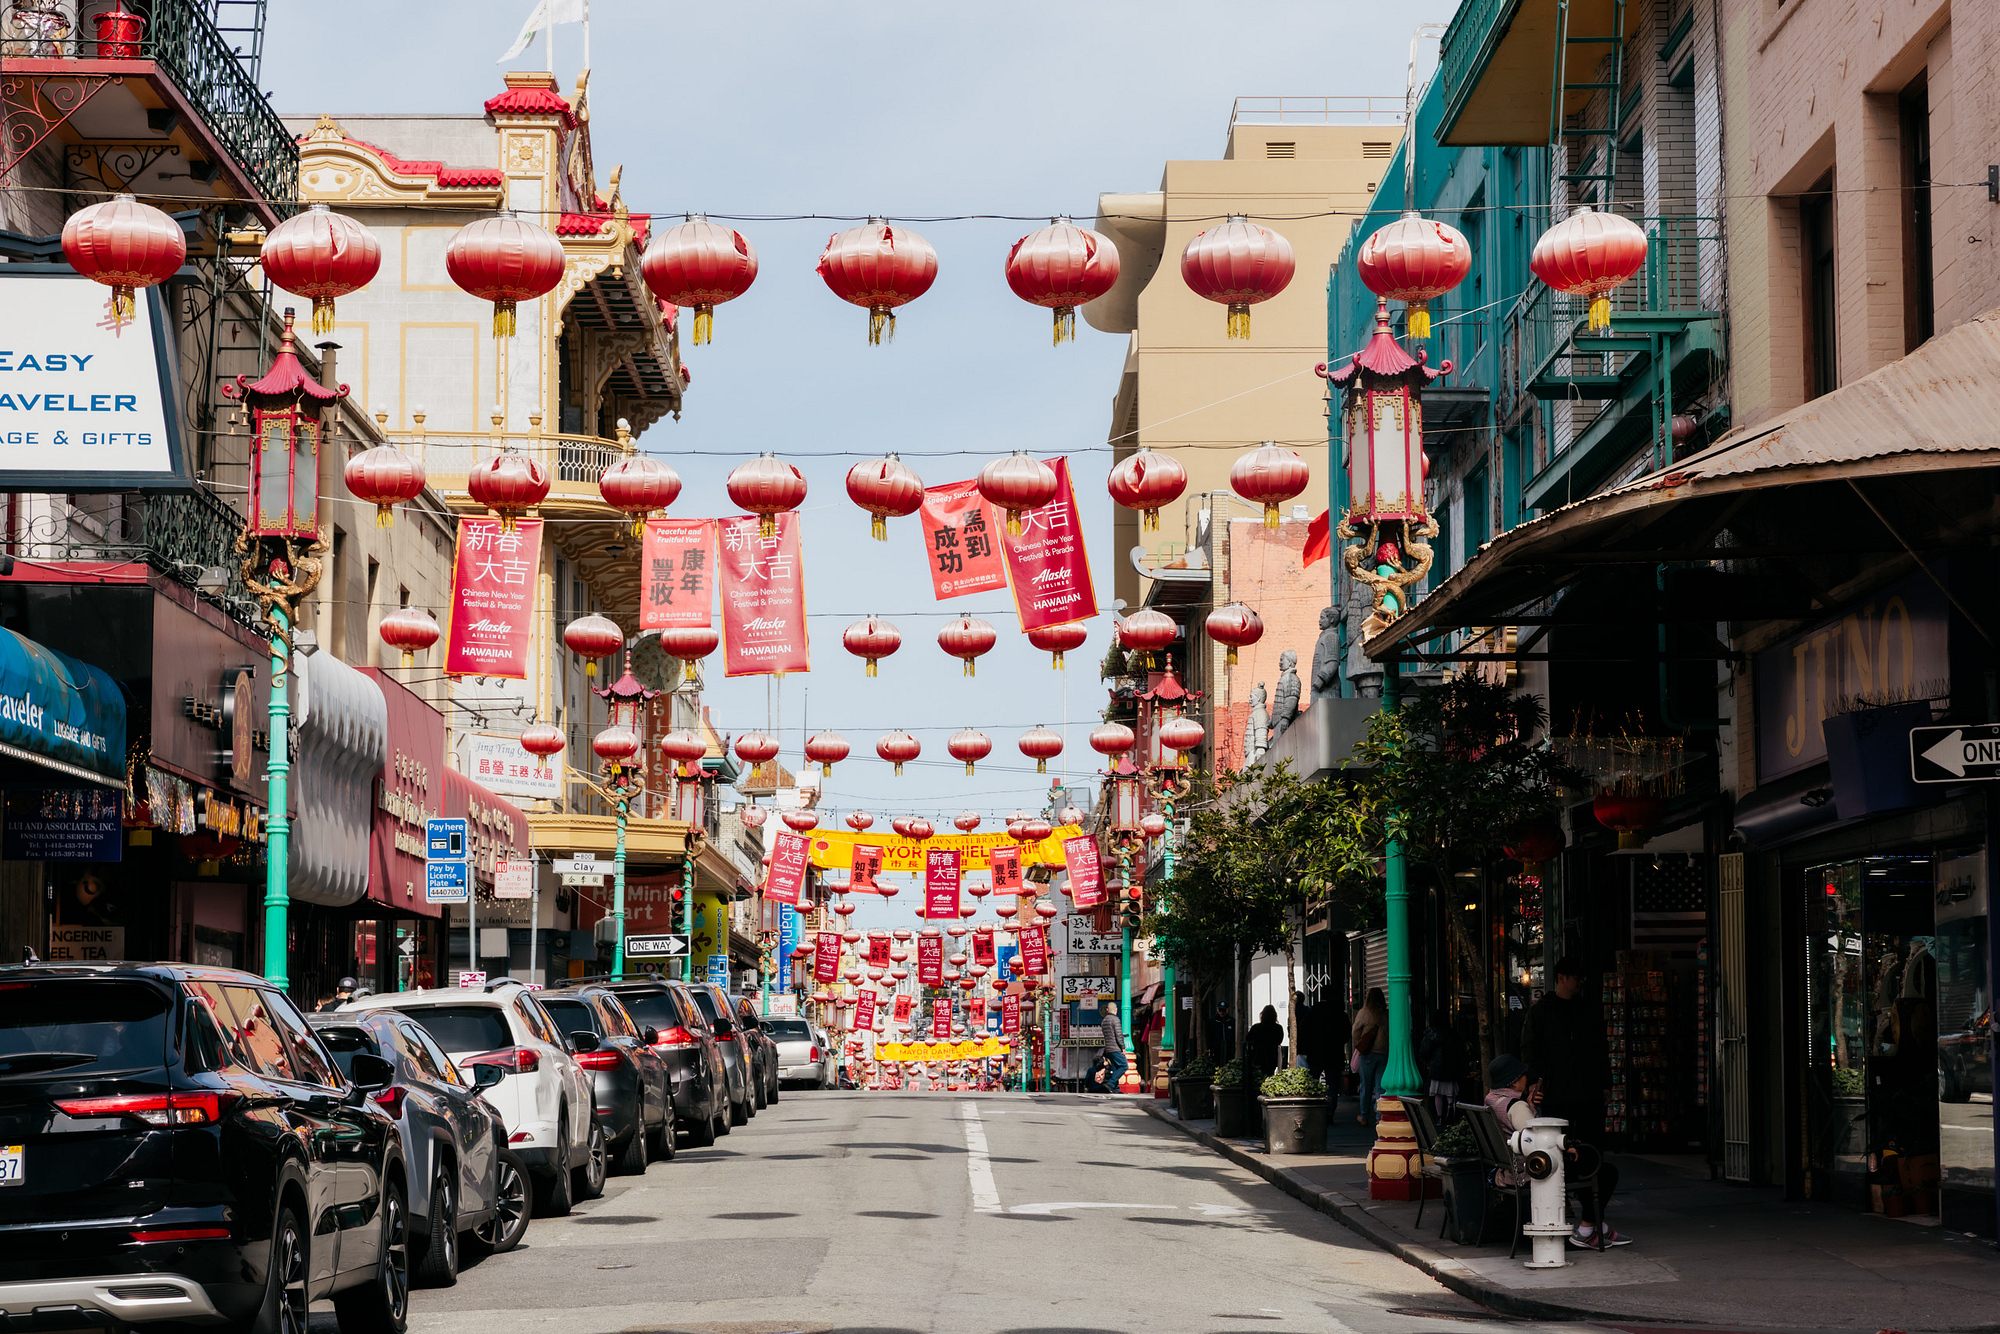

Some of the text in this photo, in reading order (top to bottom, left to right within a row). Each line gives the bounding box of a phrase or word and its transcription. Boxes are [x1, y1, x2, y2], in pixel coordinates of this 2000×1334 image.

[53, 430, 152, 445] & GIFTS
[927, 489, 980, 505] Speedy Success
[1019, 499, 1069, 536] 大吉
[465, 521, 524, 553] 新春
[656, 527, 687, 536] Peaceful
[725, 522, 783, 552] 新春
[963, 508, 991, 559] 馬到
[656, 536, 684, 544] Fruitful
[1013, 535, 1074, 554] Chinese New Year
[934, 525, 963, 574] 成功
[1018, 545, 1075, 563] Festival & Parade
[473, 554, 531, 585] 大吉
[680, 547, 706, 596] 康年
[739, 551, 794, 583] 大吉
[649, 558, 675, 606] 豐收
[1031, 566, 1073, 585] Alaska
[1038, 580, 1070, 590] AIRLINES
[461, 588, 526, 600] Chinese New Year
[730, 586, 795, 599] Chinese New Year
[463, 599, 522, 611] Festival & Parade
[733, 596, 793, 609] Festival & Parade
[1033, 592, 1082, 610] HAWAIIAN
[1050, 605, 1068, 613] AIRLINES
[468, 619, 512, 634] Alaska
[742, 617, 787, 631] Alaska
[472, 632, 506, 640] AIRLINES
[748, 630, 783, 638] AIRLINES
[462, 647, 513, 659] HAWAIIAN
[740, 644, 792, 657] HAWAIIAN
[54, 719, 106, 753] LUGGAGE AND GIFTS
[475, 742, 516, 757] Jing Ying
[8, 822, 116, 832] LUI AND ASSOCIATES, INC.
[429, 823, 464, 833] Pay here
[777, 834, 804, 851] 新春
[1066, 838, 1092, 854] 新春
[780, 849, 805, 866] 大吉
[928, 852, 955, 866] 新春
[1074, 851, 1098, 867] 大吉
[429, 864, 455, 873] Pay by
[497, 862, 531, 873] NO PARKING
[573, 863, 595, 872] Clay
[854, 860, 865, 883] 如意
[933, 866, 958, 880] 大吉
[1007, 858, 1019, 880] 康年
[429, 872, 457, 880] License
[994, 864, 1006, 886] 豐收
[627, 885, 668, 903] Mini
[819, 933, 837, 944] 新春
[1020, 929, 1039, 940] 新春
[631, 941, 672, 951] ONE WAY
[821, 944, 839, 955] 大吉
[919, 939, 938, 948] 新春
[1025, 938, 1043, 949] 大吉
[1072, 937, 1101, 950] 北京
[81, 946, 107, 959] TEA
[923, 947, 941, 957] 大吉
[773, 1003, 793, 1013] Crafts
[861, 999, 874, 1008] 大吉
[1006, 1003, 1018, 1011] 大吉
[938, 1007, 951, 1016] 大吉
[899, 1045, 985, 1056] MAYOR DANIEL LURIE
